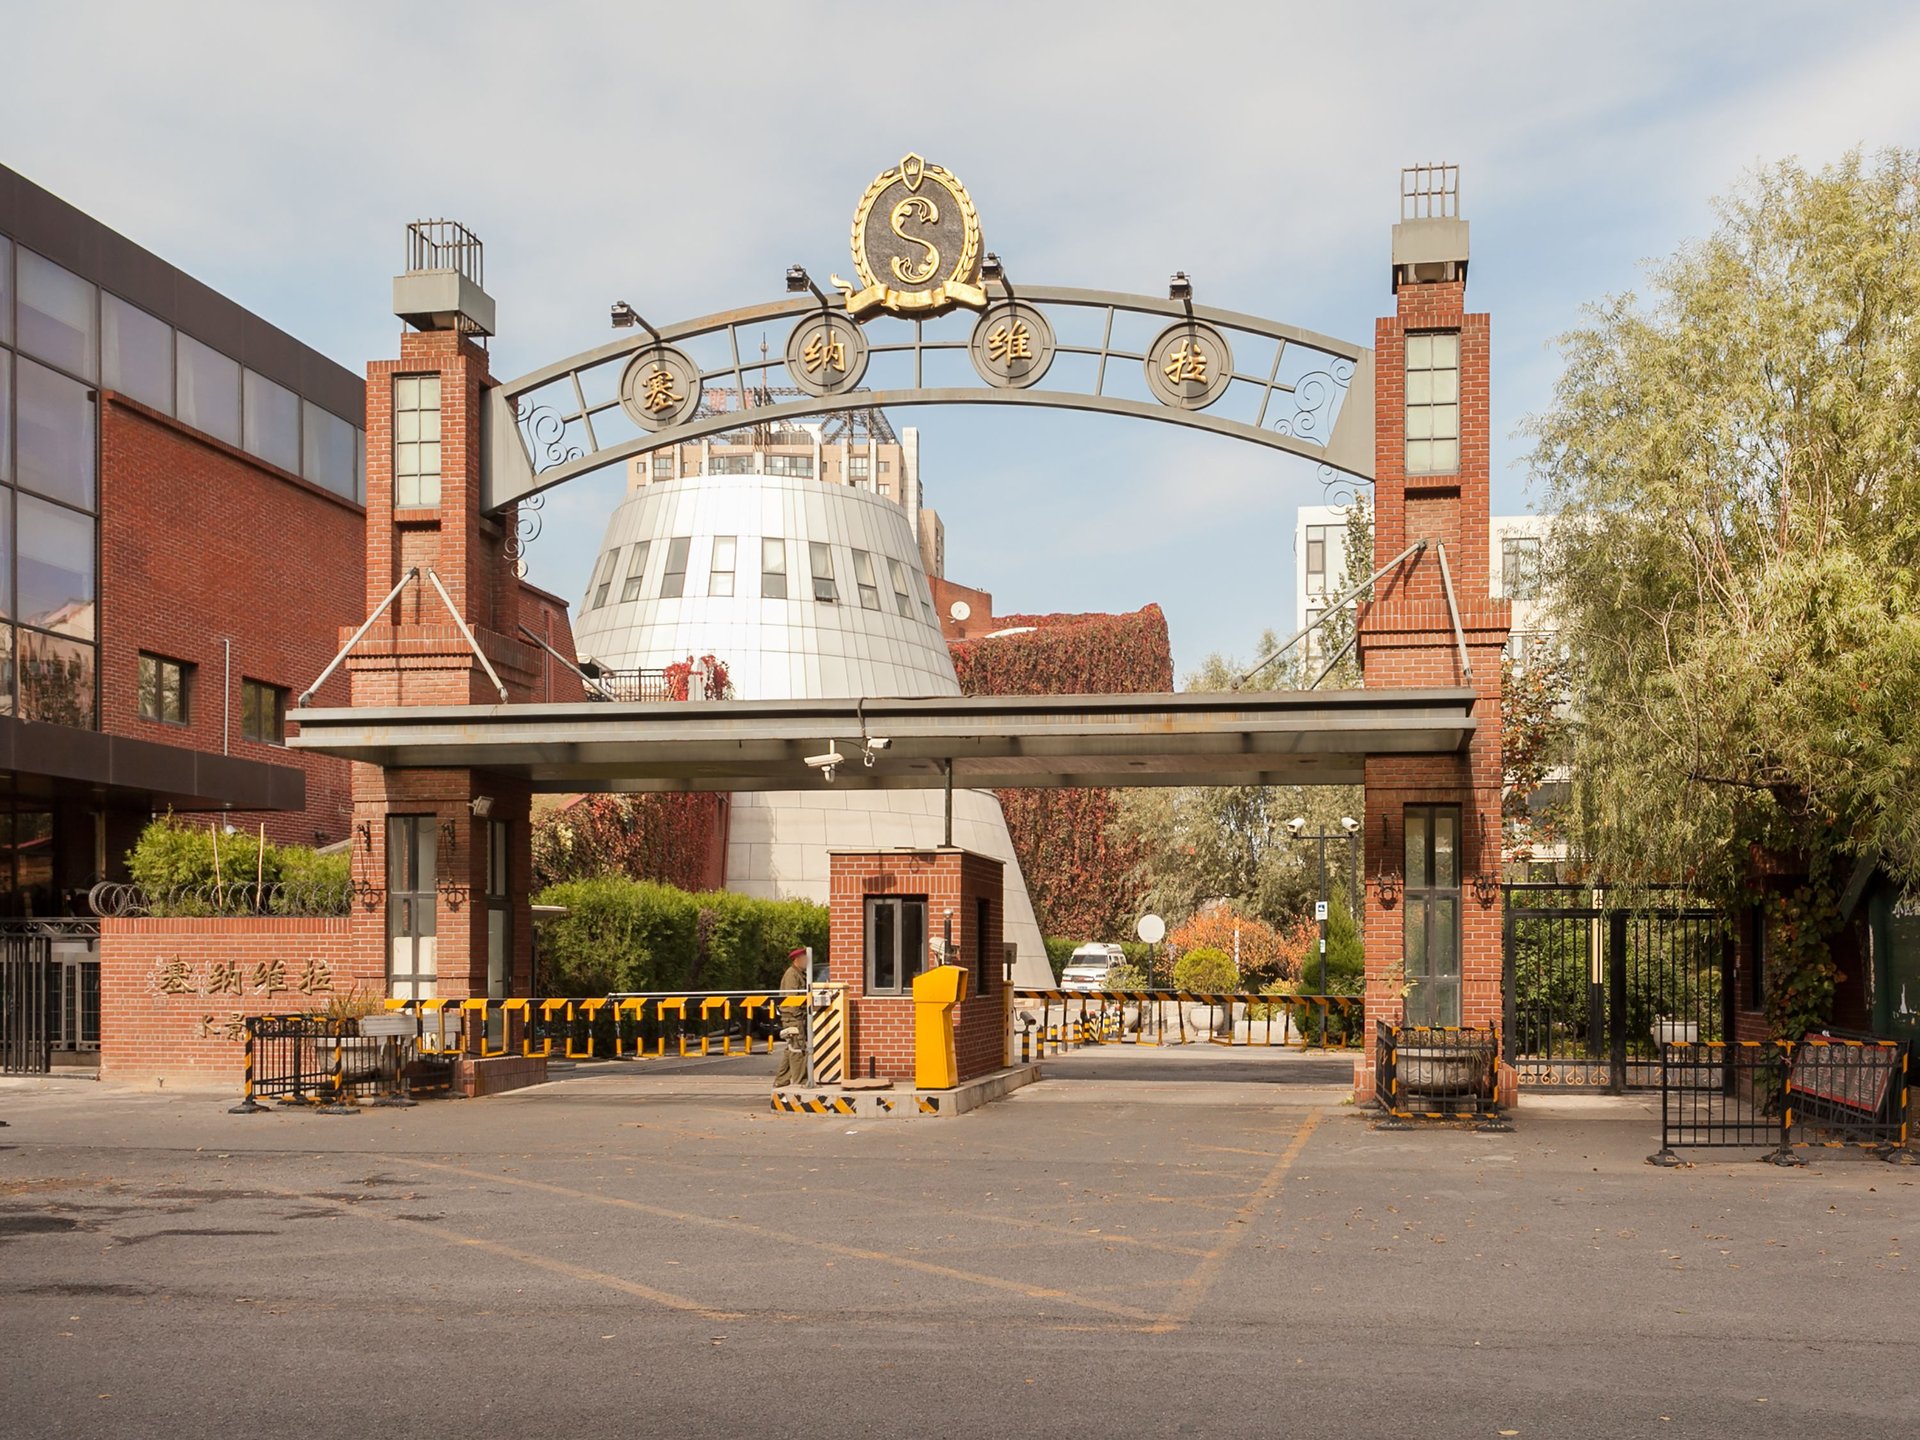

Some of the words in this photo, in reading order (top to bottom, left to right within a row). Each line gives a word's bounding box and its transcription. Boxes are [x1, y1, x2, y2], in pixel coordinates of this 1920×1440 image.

[891, 196, 940, 284] S
[641, 320, 1208, 414] 塞纳维拉
[160, 954, 334, 999] 塞纳维拉
